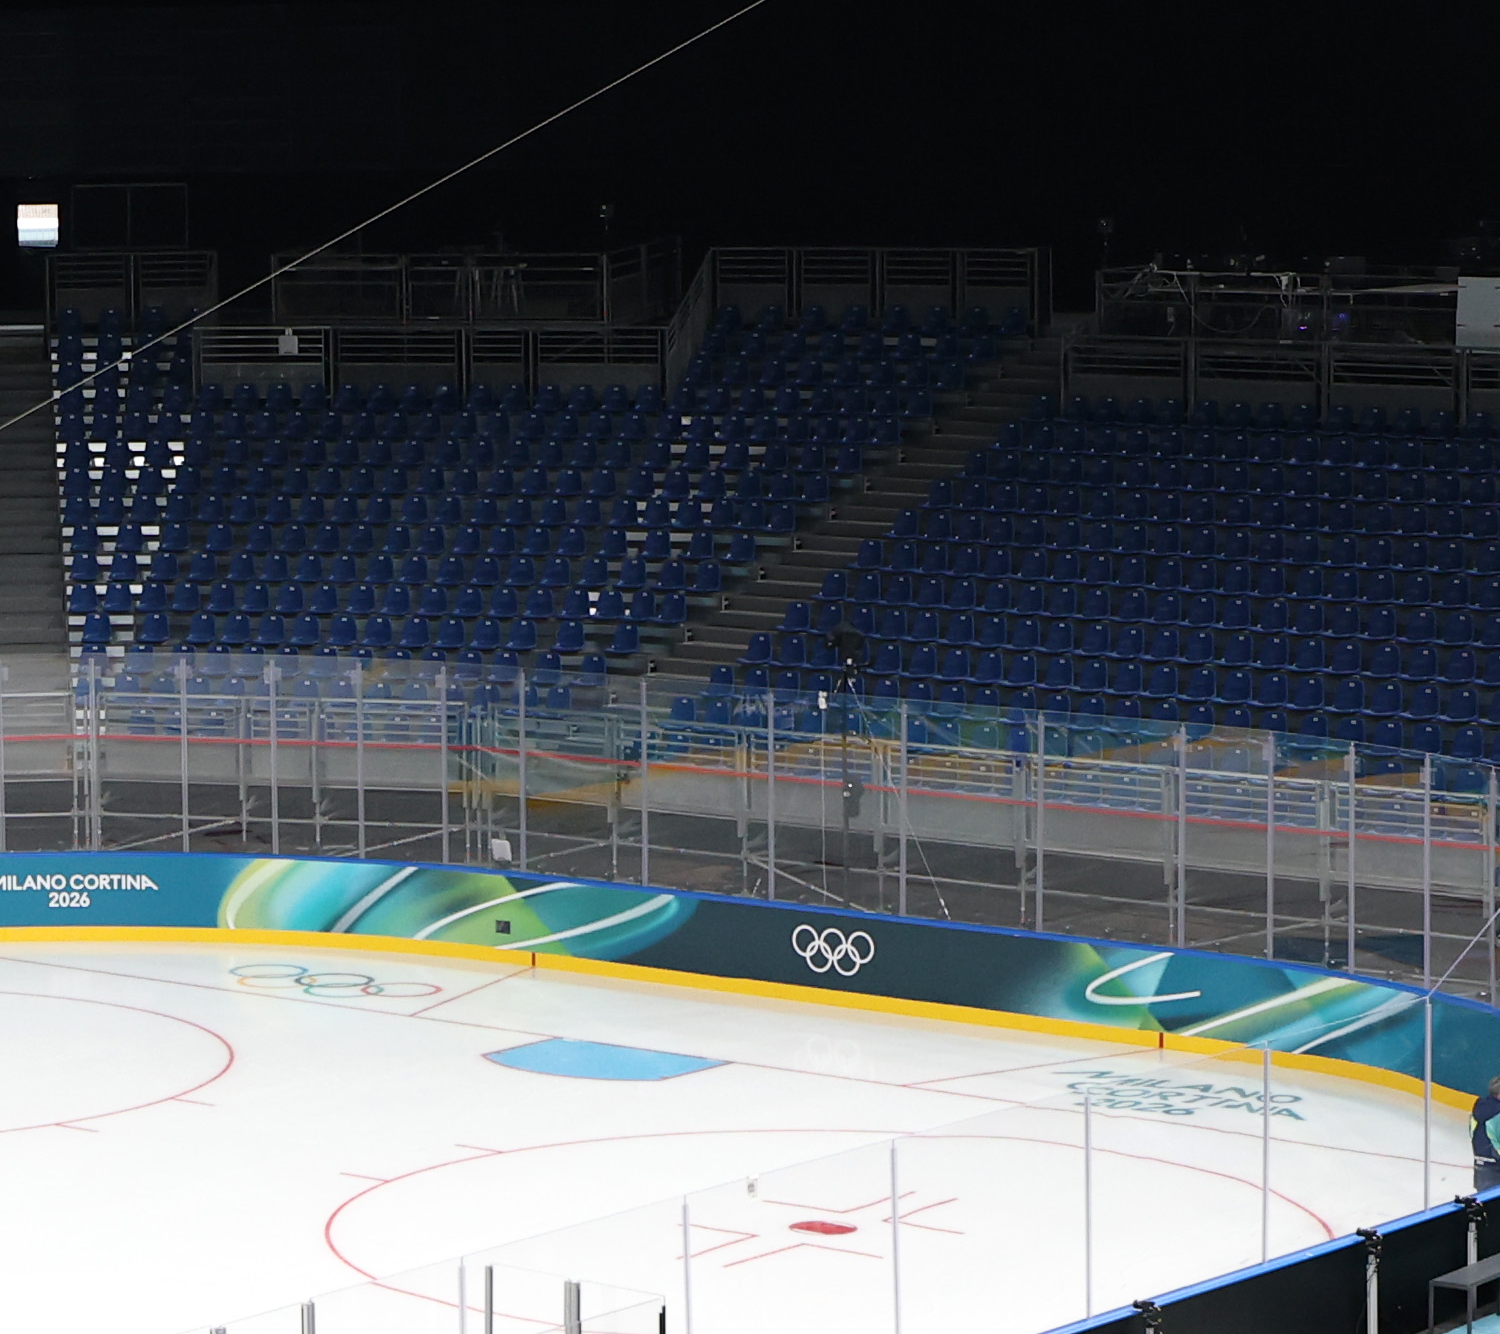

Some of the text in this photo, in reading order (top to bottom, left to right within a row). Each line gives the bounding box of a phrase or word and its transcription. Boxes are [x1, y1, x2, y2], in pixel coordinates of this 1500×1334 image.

[69, 874, 159, 890] CORTINA
[48, 892, 91, 908] 2026
[1050, 1070, 1302, 1104] MILANO
[1067, 1081, 1305, 1120] CORTINA
